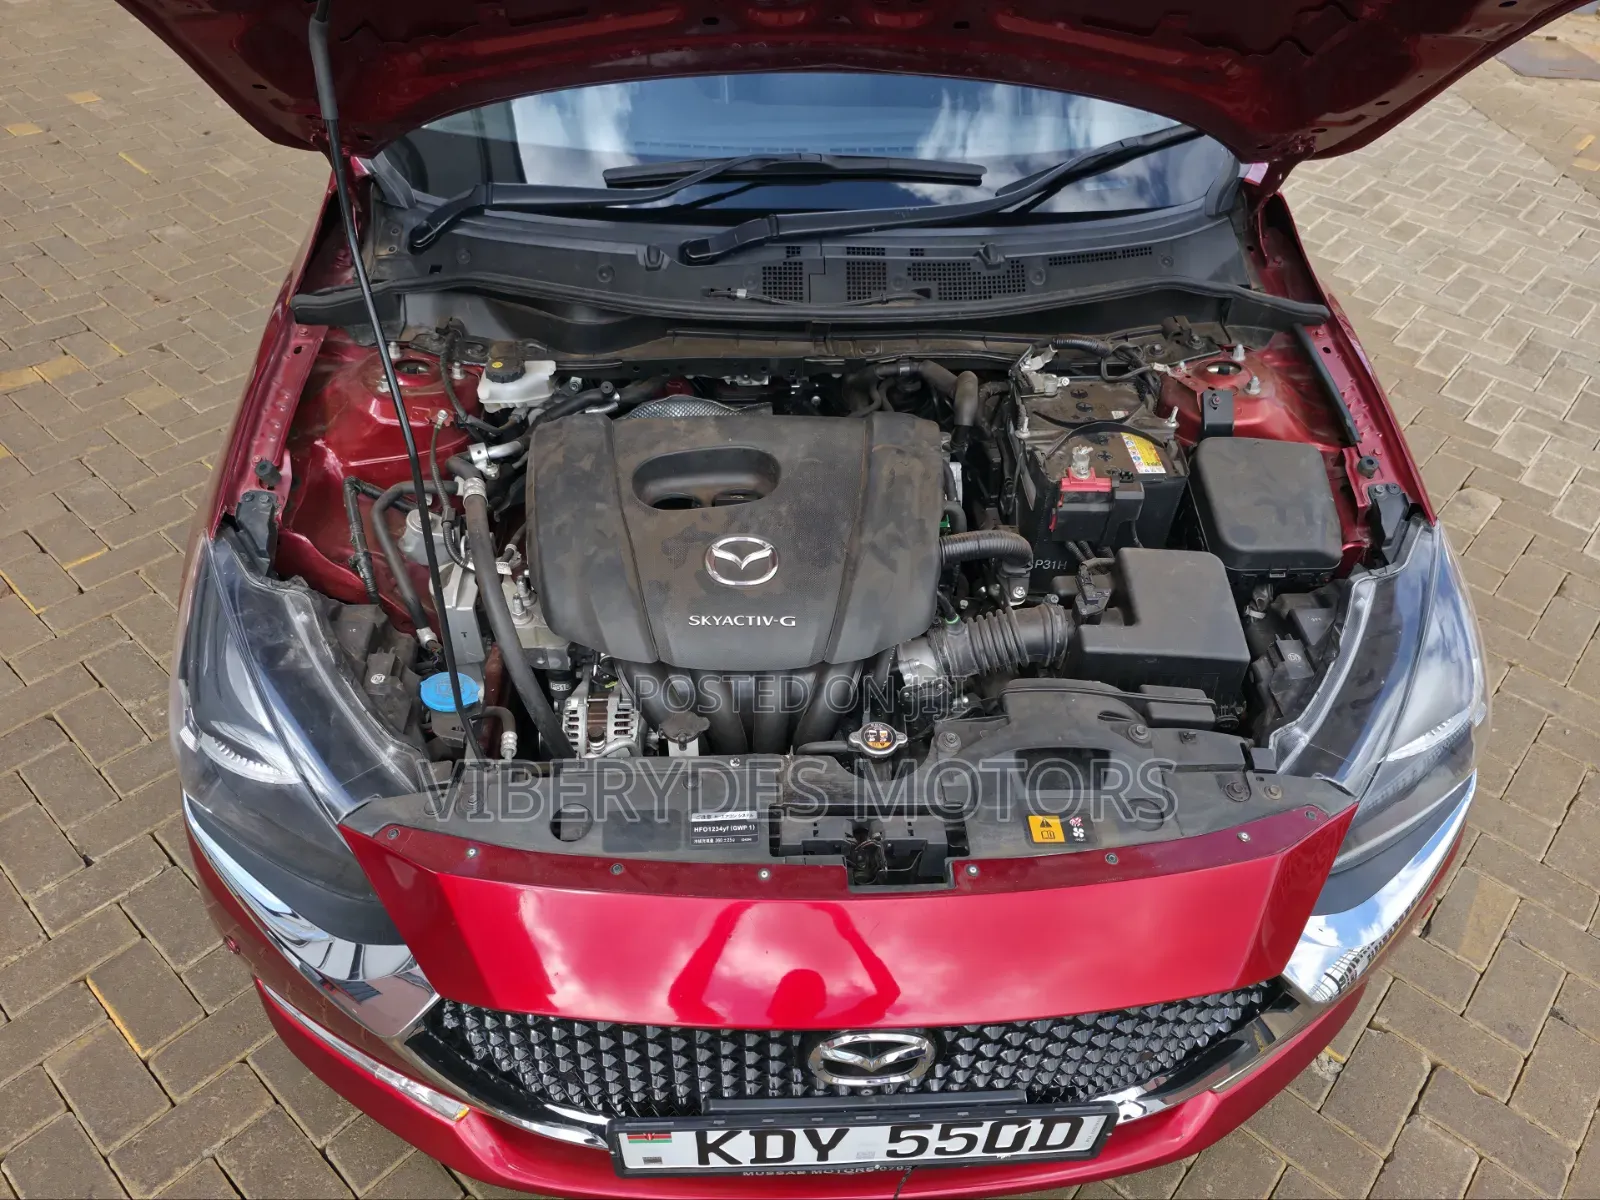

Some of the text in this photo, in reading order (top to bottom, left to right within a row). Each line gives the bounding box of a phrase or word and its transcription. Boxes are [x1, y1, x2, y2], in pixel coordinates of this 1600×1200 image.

[688, 615, 796, 627] SKYACTIV-G
[693, 825, 729, 833] HFO1234yf
[695, 1128, 850, 1165] KDY
[886, 1117, 1085, 1159] 550D
